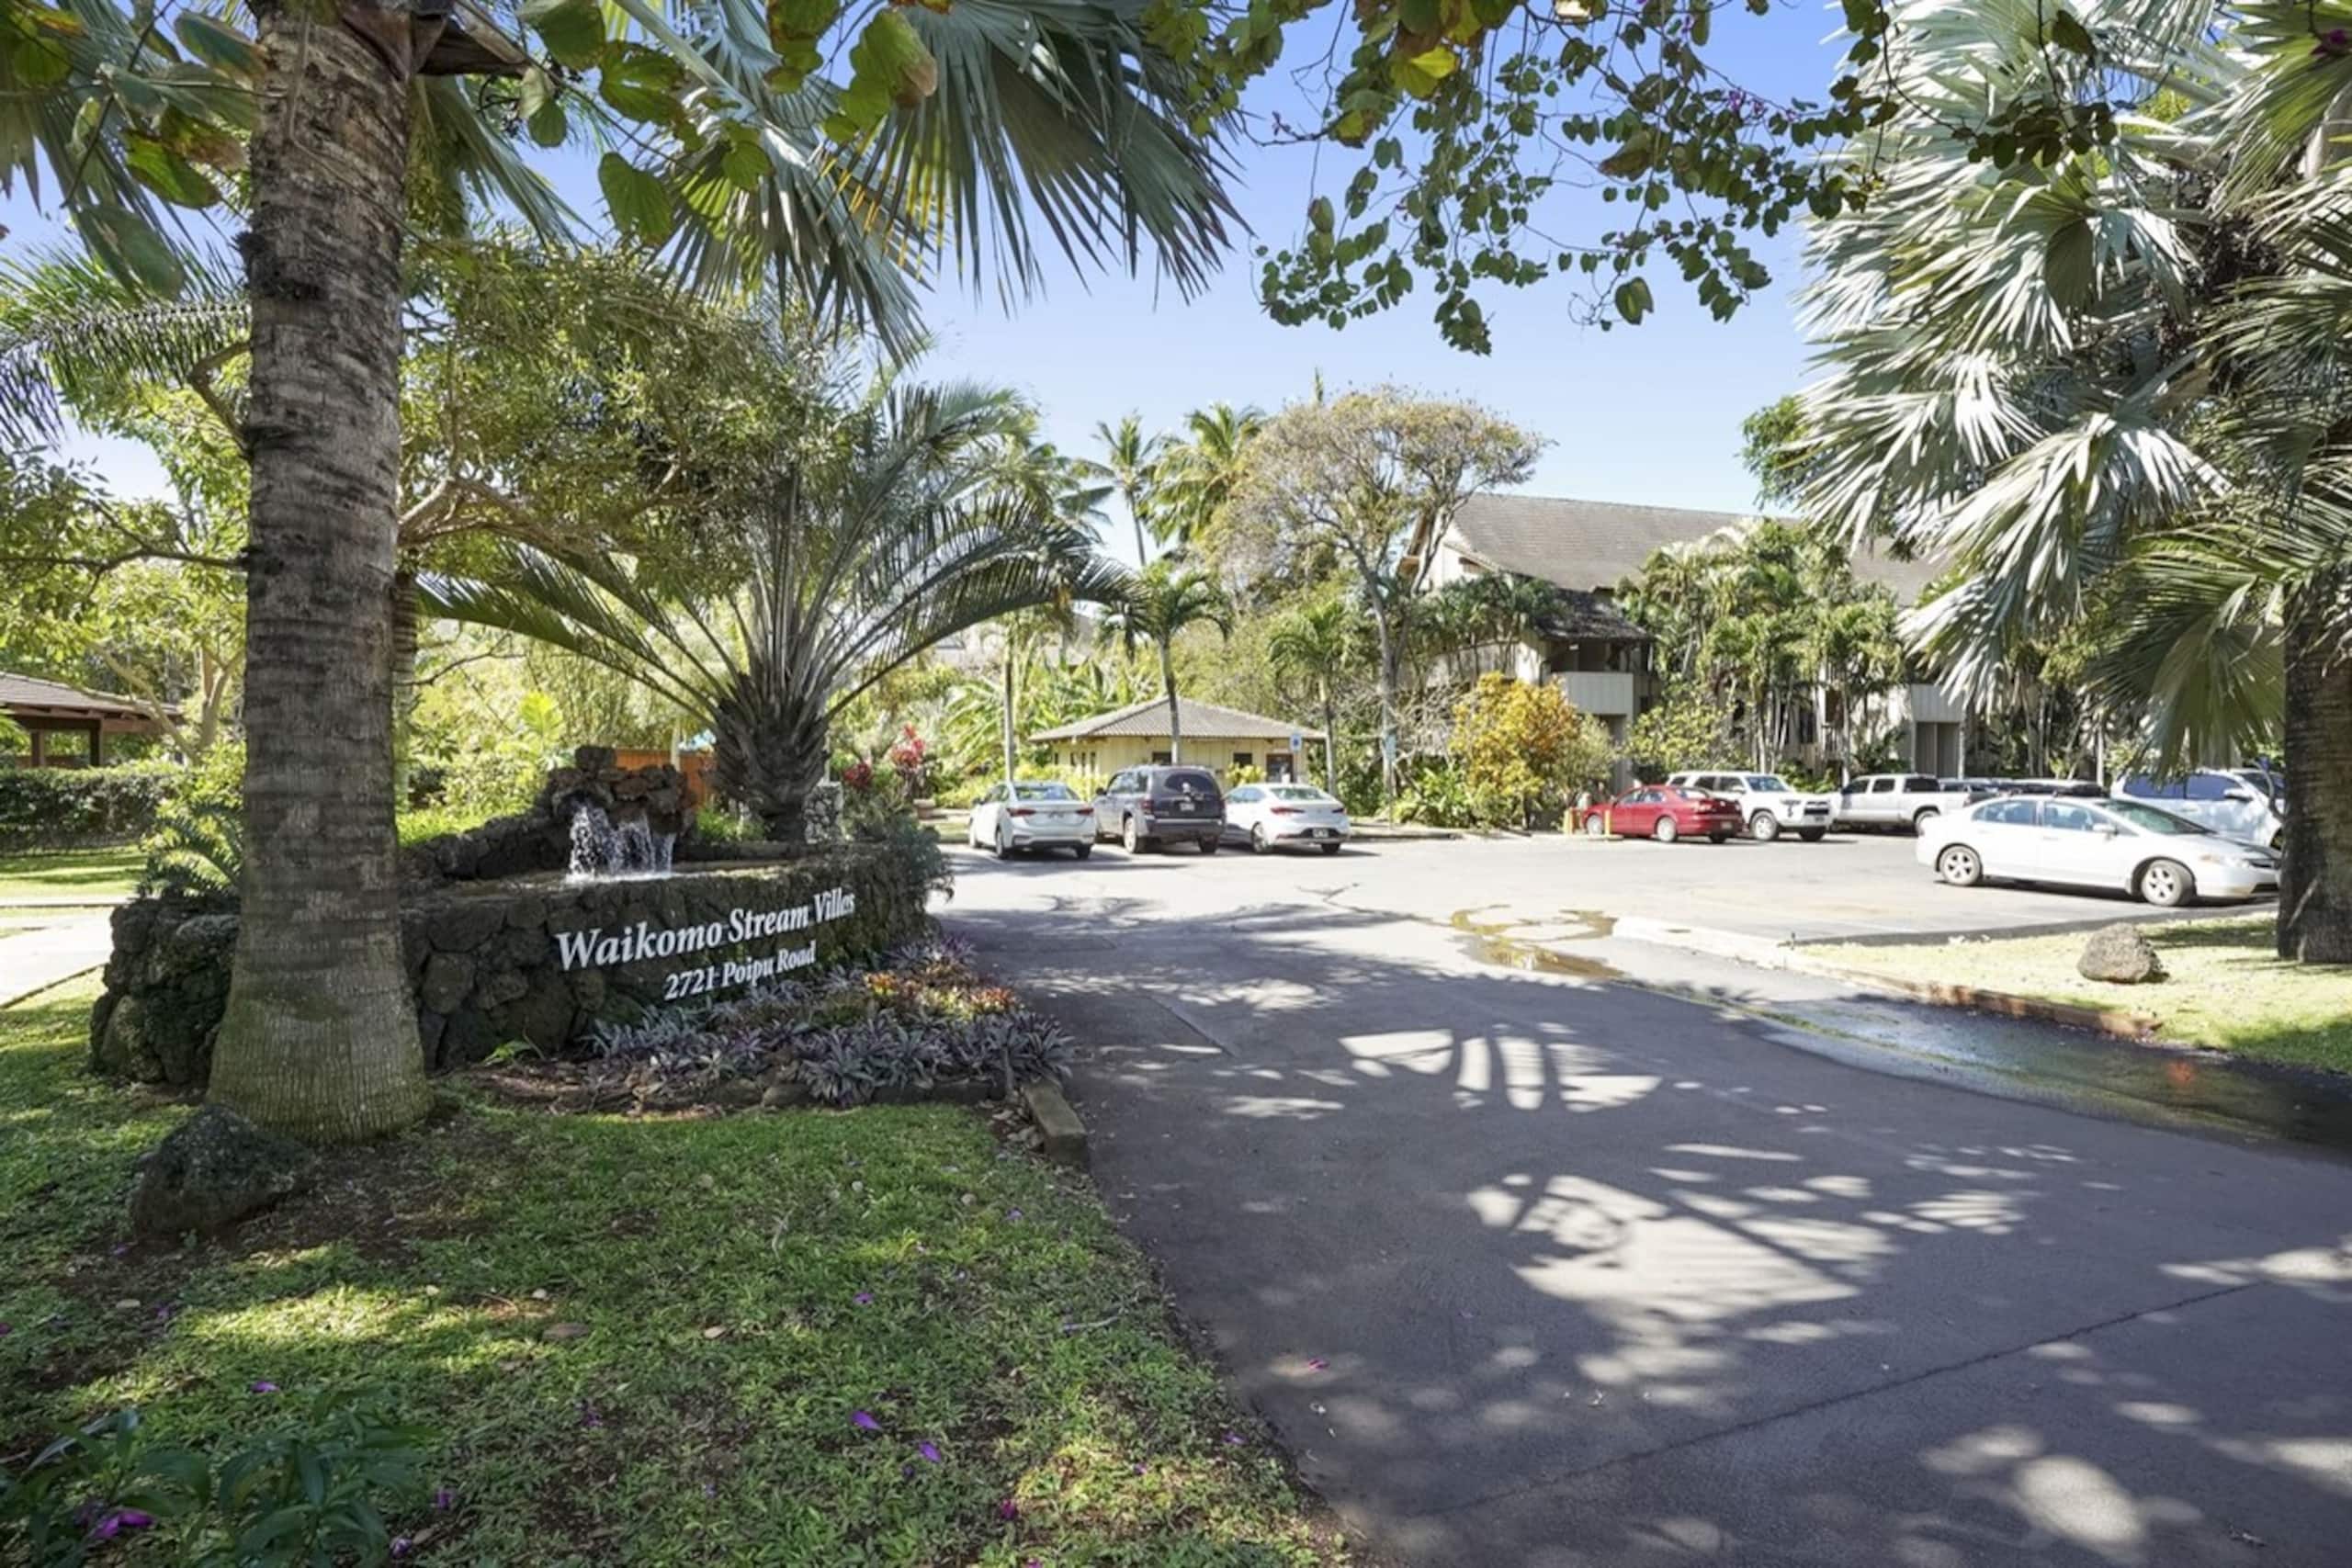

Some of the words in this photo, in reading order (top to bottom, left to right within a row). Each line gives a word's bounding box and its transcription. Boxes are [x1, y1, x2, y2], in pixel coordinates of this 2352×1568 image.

[553, 920, 723, 971] Waikomo
[728, 904, 809, 943] Stream
[664, 965, 715, 1001] 2721
[721, 956, 775, 987] Poipu
[776, 939, 817, 974] Road
